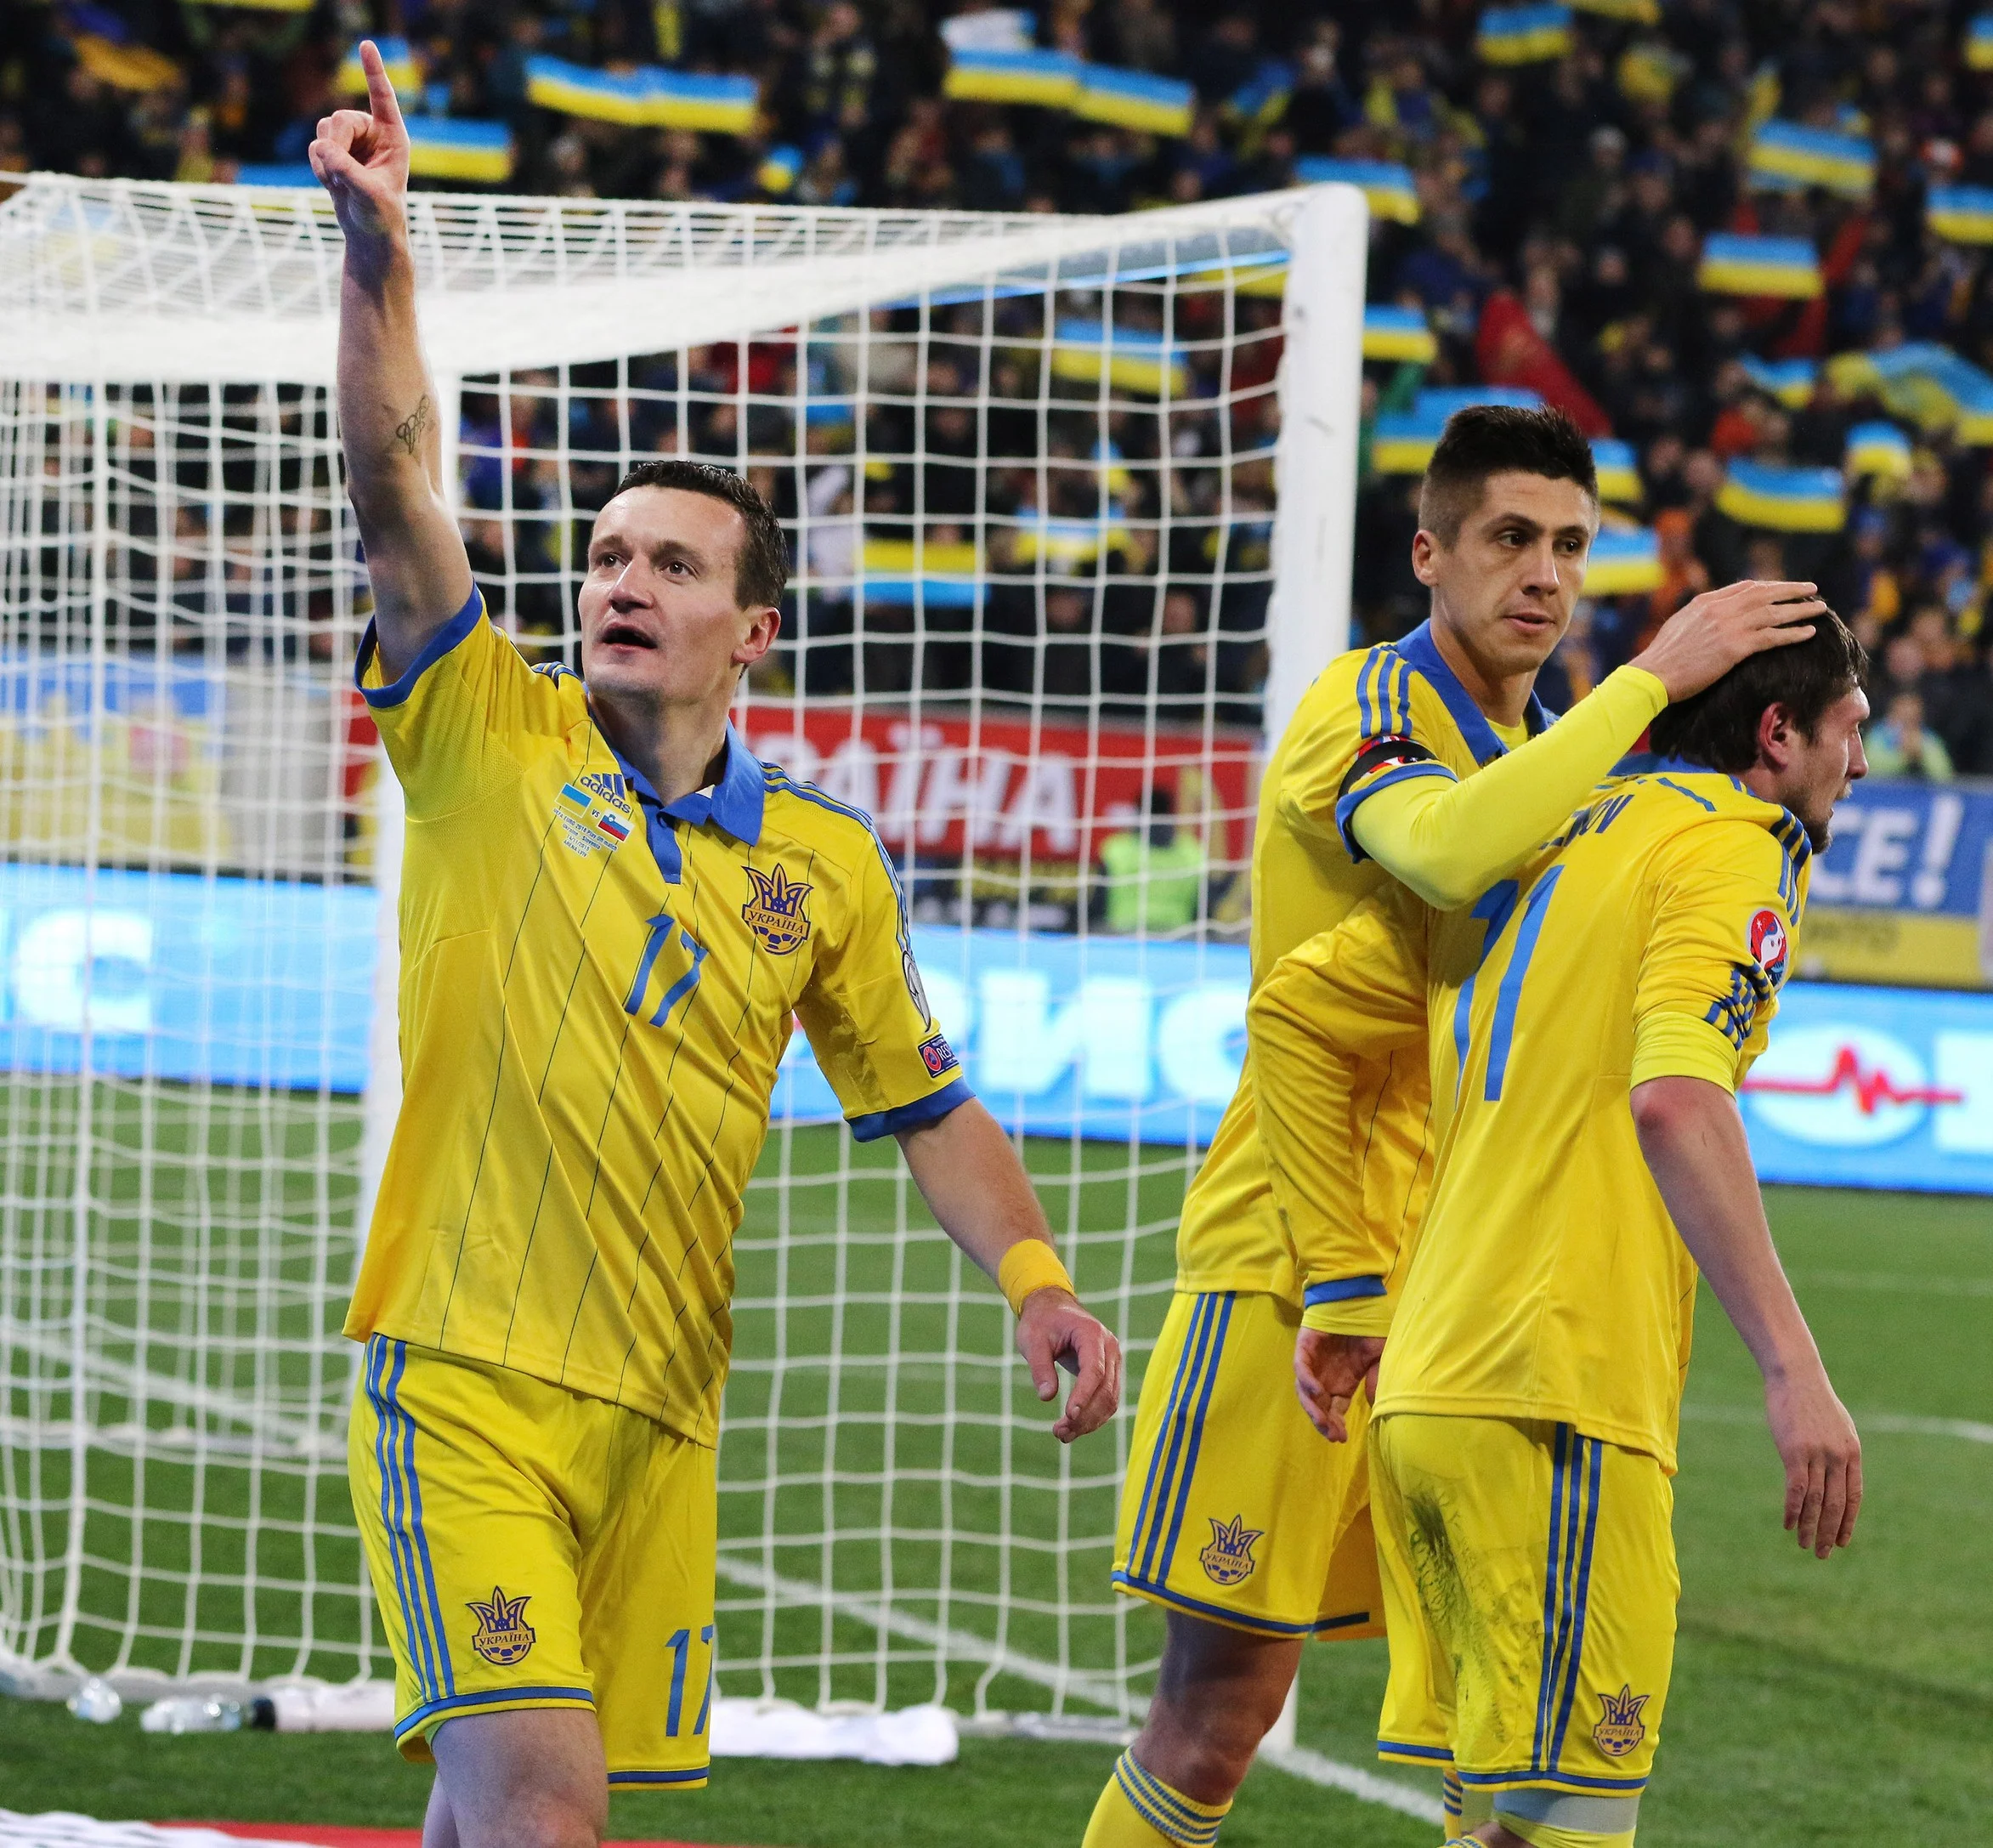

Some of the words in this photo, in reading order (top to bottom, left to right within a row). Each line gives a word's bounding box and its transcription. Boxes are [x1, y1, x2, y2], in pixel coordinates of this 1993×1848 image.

[580, 776, 631, 813] adidas
[748, 910, 804, 934] УКРАЇНА
[624, 913, 709, 1029] 17
[1453, 864, 1566, 1112] 11
[478, 1632, 529, 1647] УКРАЇНА
